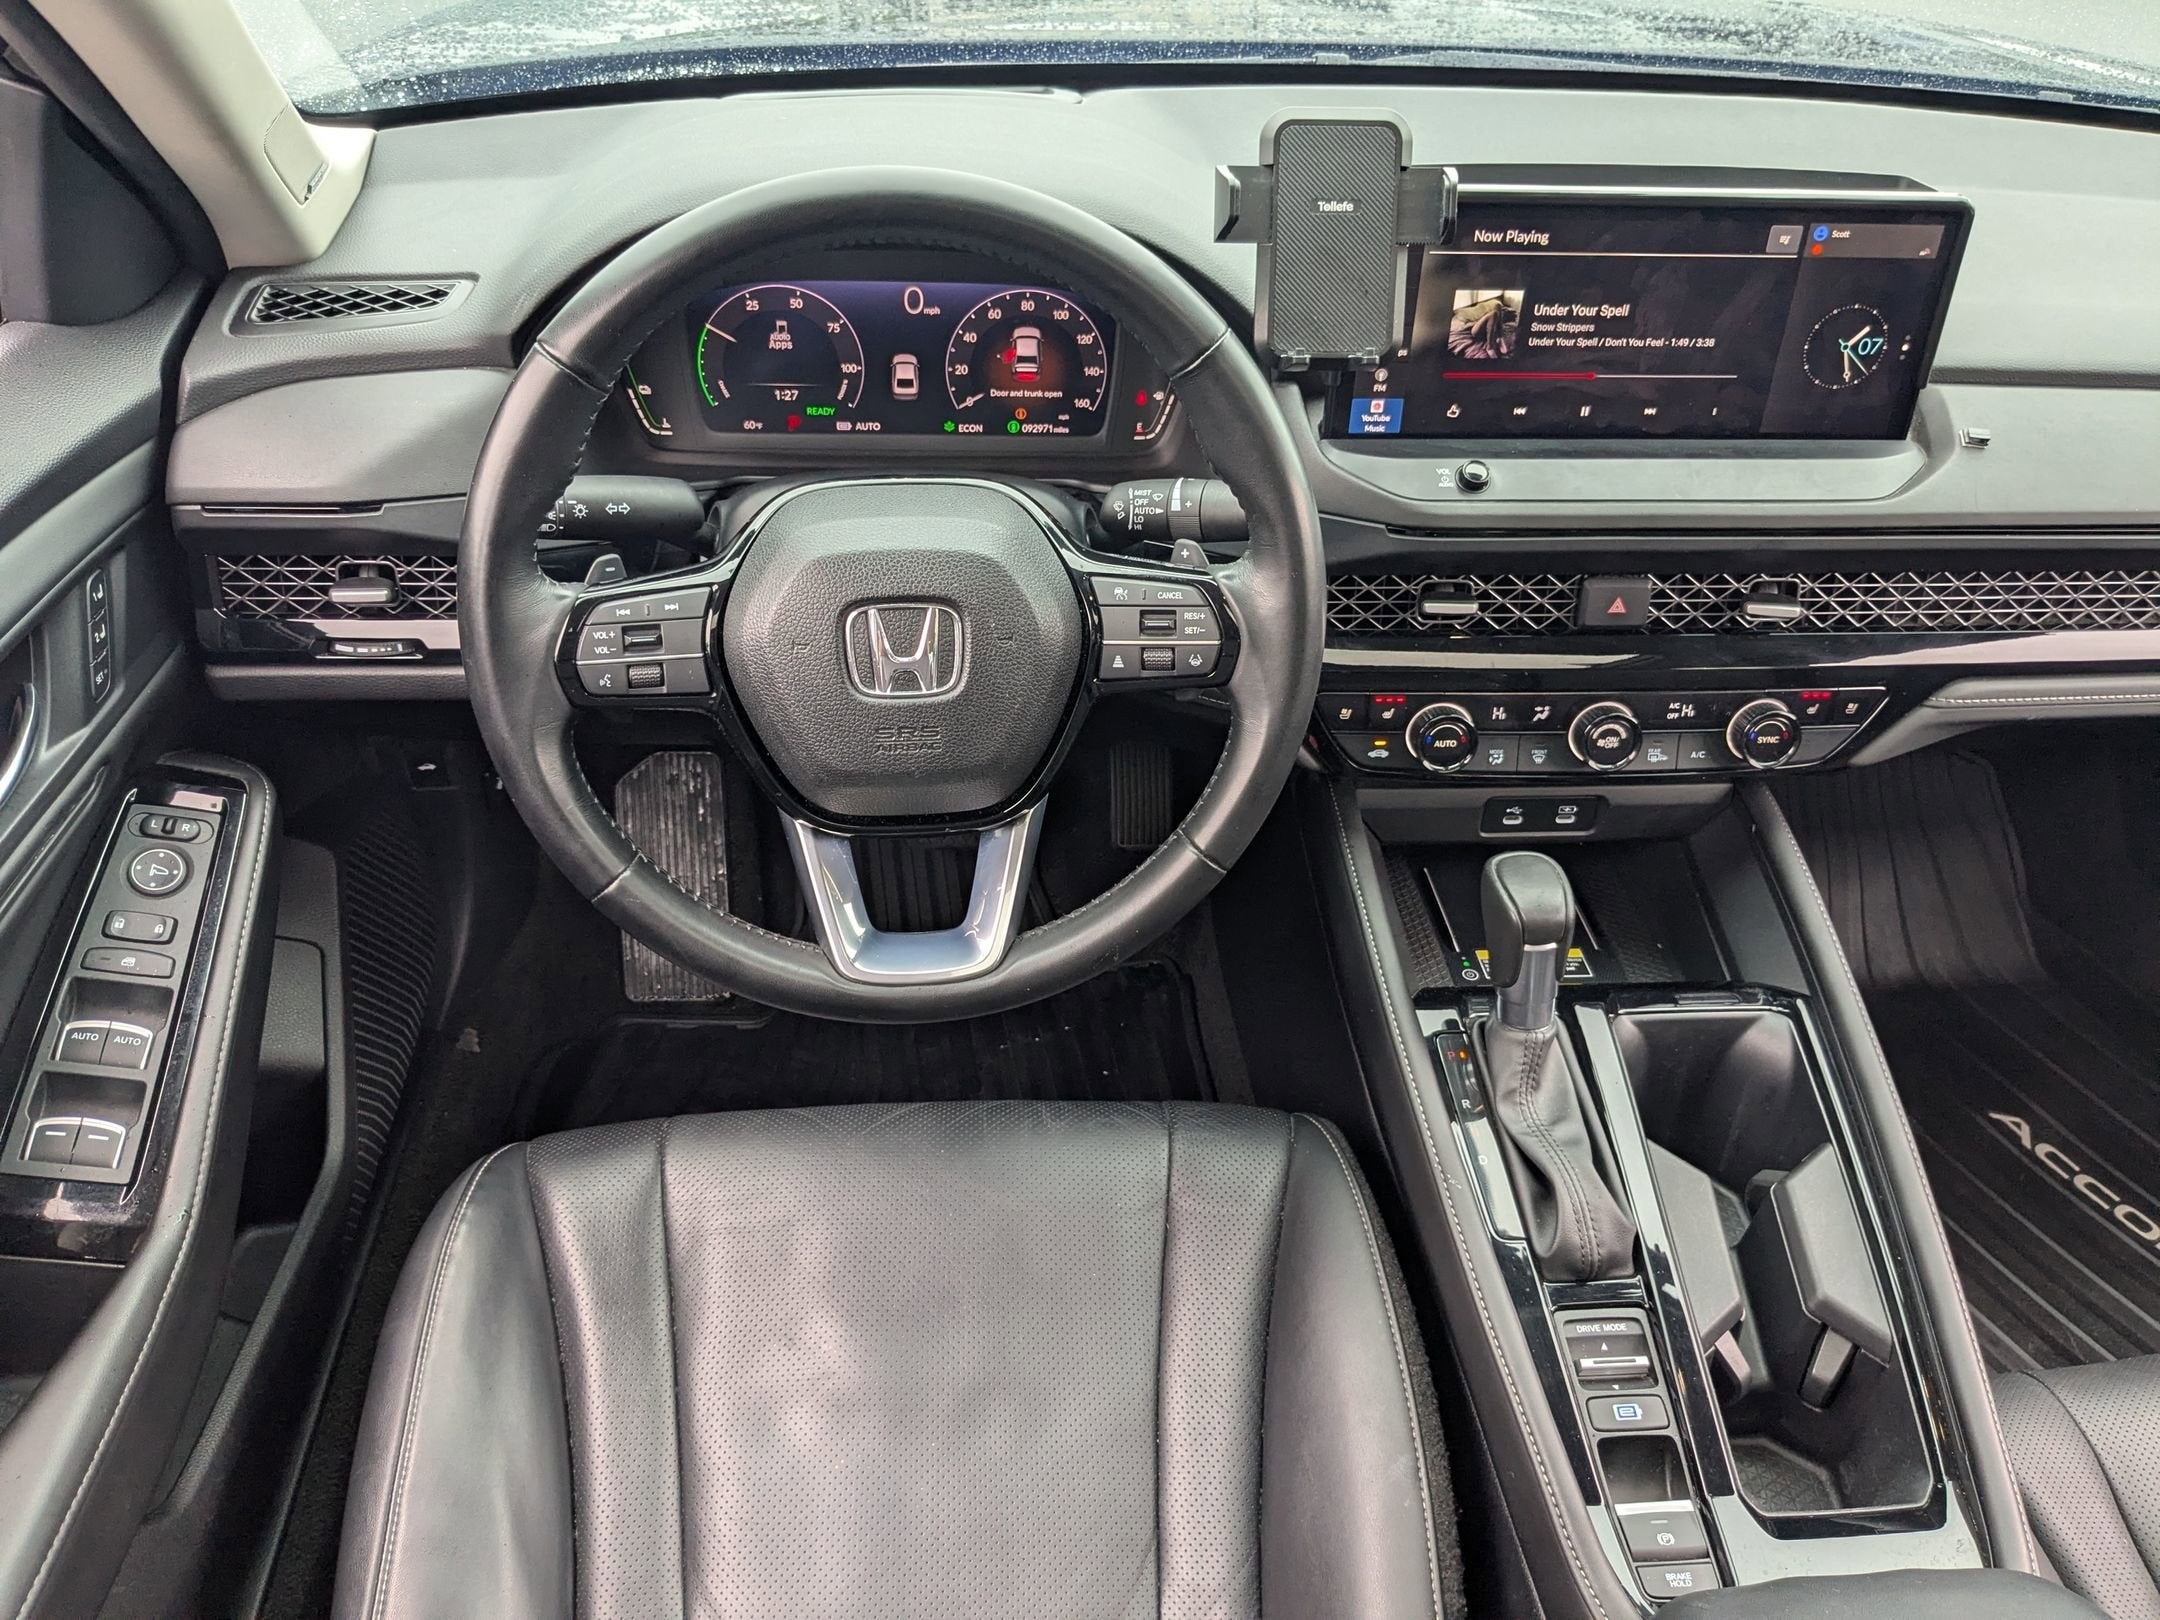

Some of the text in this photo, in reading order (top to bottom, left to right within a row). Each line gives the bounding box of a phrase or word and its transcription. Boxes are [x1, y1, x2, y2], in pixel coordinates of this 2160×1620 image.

[1317, 200, 1354, 212] Tollefe
[1473, 230, 1550, 246] Now Playing
[1831, 229, 1851, 239] Scott
[745, 300, 760, 311] 25
[789, 298, 804, 310] 50
[903, 286, 925, 315] 0
[923, 306, 941, 316] mph
[1021, 300, 1035, 312] 80
[987, 309, 1002, 320] 60
[1052, 309, 1070, 321] 100
[1533, 304, 1630, 319] Under Your Spell
[826, 322, 842, 334] 75
[1530, 322, 1595, 334] Snow Strippers
[962, 332, 977, 344] 40
[1076, 334, 1093, 345] 120
[1528, 337, 1555, 347] Under
[1555, 337, 1575, 347] Your
[1576, 337, 1598, 348] Spell
[1604, 337, 1628, 347] Don't
[1628, 338, 1645, 347] You
[1645, 338, 1664, 347] Feel
[1670, 338, 1689, 347] 1:49
[1695, 338, 1716, 348] 3:38
[768, 340, 793, 351] Apps
[1857, 338, 1884, 355] 07
[840, 363, 858, 374] 100
[954, 364, 969, 376] 20
[1083, 366, 1100, 377] 140
[1373, 383, 1388, 393] FM
[774, 389, 800, 402] 1:27
[989, 388, 1063, 399] Door and trunk open
[1073, 398, 1090, 409] 160
[806, 407, 836, 416] READY
[1361, 414, 1391, 422] YouTube
[855, 422, 881, 431] AUTO
[958, 424, 984, 433] ECON
[1021, 424, 1070, 434] 092971 miles
[1364, 424, 1386, 433] Music
[1133, 489, 1152, 497] MIST
[1134, 498, 1150, 506] OFF
[1134, 506, 1155, 515] AUTO
[1133, 515, 1145, 523] LO
[1157, 591, 1184, 600] CANCEL
[1666, 712, 1680, 720] OFF
[1433, 739, 1458, 749] AUTO
[1756, 735, 1781, 744] SYNC
[1690, 750, 1706, 759] A/C
[150, 819, 158, 828] L
[182, 823, 191, 832] R
[71, 1031, 100, 1041] AUTO
[113, 1035, 142, 1046] AUTO
[1461, 1099, 1471, 1109] R
[1477, 1155, 1489, 1165] D
[1988, 1112, 2160, 1250] ACCO
[1575, 1323, 1628, 1334] DRIVE MODE
[1665, 1572, 1693, 1581] BRAKE
[1669, 1579, 1693, 1588] HOLD
